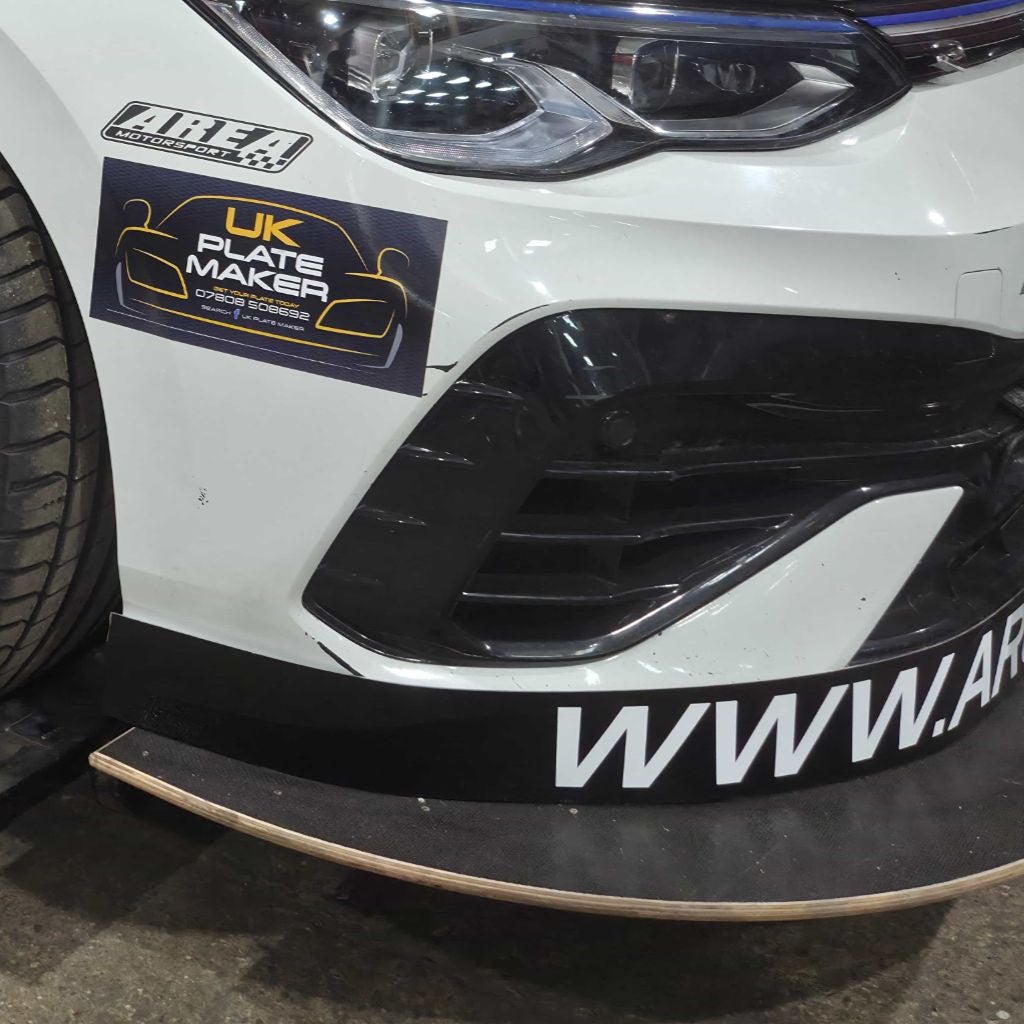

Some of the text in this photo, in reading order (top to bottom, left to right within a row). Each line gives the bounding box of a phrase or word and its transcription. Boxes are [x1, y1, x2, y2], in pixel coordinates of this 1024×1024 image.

[114, 129, 233, 158] MOTORSPORT
[123, 106, 298, 159] AREA
[226, 206, 304, 248] UK
[197, 232, 325, 277] PLATE
[185, 254, 330, 303] MAKER
[229, 289, 250, 298] YOUR
[250, 294, 274, 304] PLATE
[275, 299, 300, 308] TODAY
[195, 288, 310, 322] 07808 508692
[201, 304, 231, 316] SEARCH
[252, 316, 276, 326] PLATE
[277, 322, 305, 332] MAKER
[555, 602, 1024, 789] WWW.AR
